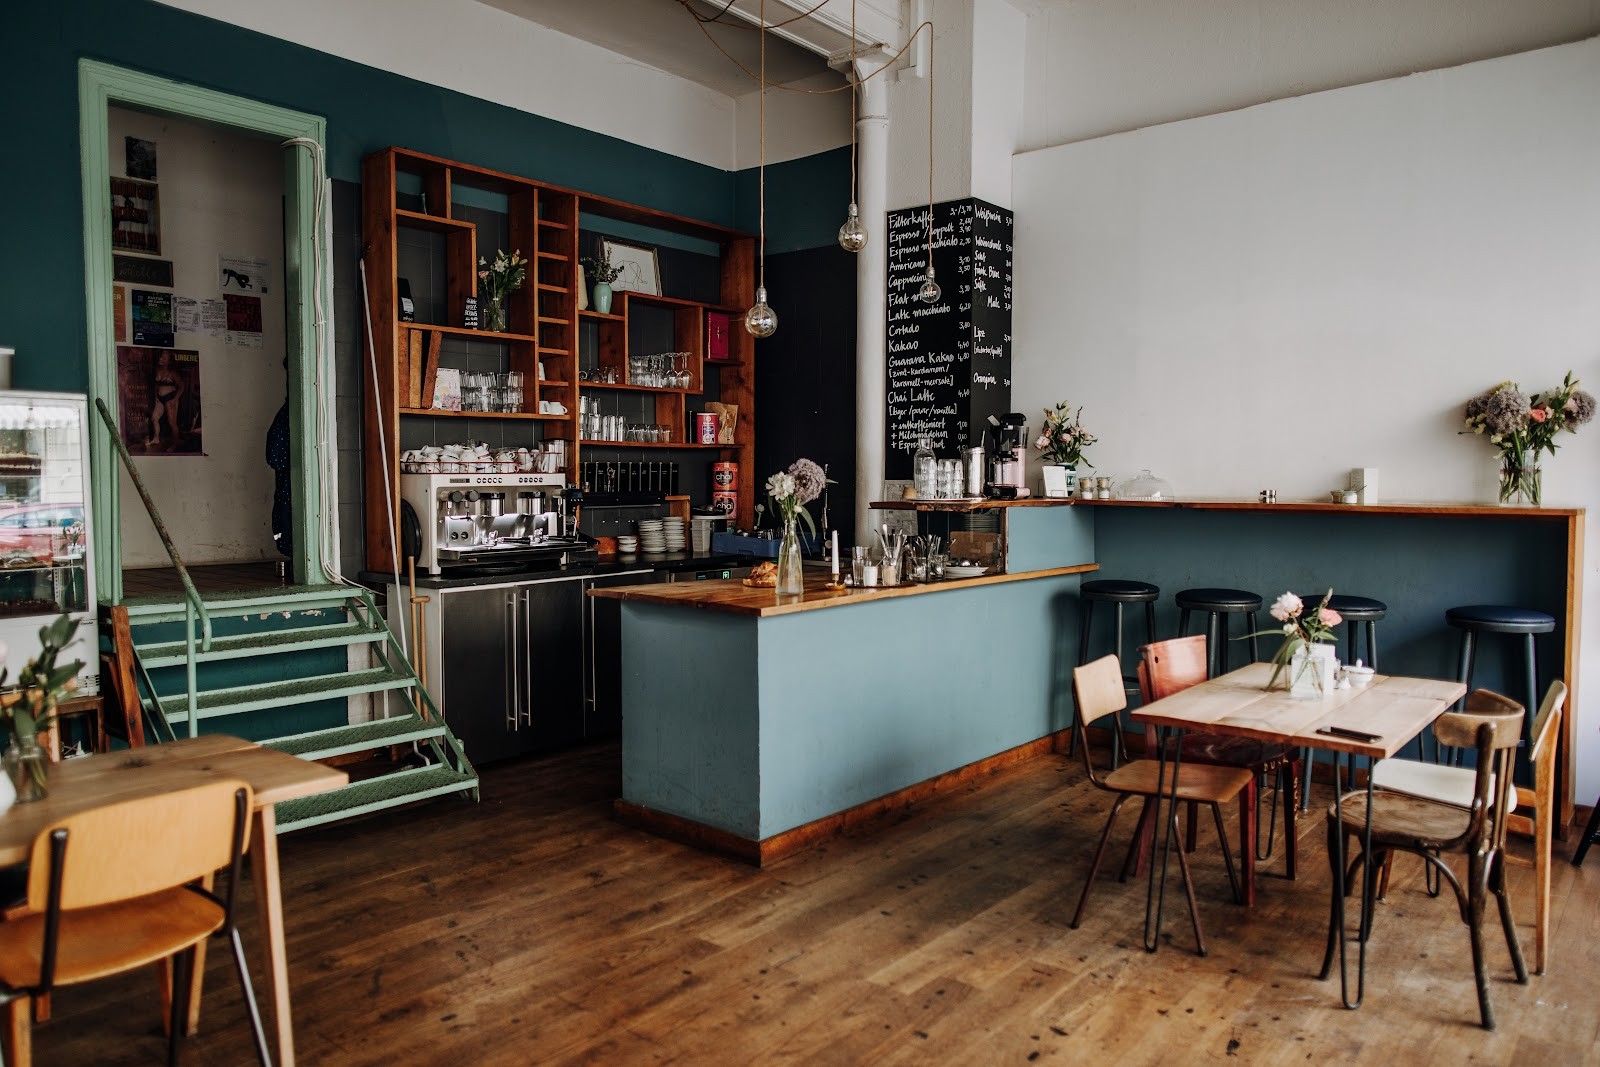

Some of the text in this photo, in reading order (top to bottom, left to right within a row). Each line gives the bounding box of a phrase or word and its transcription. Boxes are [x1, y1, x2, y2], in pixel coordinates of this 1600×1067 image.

[889, 230, 920, 247] Espresso
[889, 245, 920, 262] Espresso
[889, 259, 926, 272] Americano
[887, 293, 910, 307] Flat
[888, 308, 910, 322] Latte
[912, 303, 951, 317] macchiato
[888, 323, 920, 337] Cortado
[888, 339, 919, 353] Kakao
[888, 355, 926, 368] Guarana
[928, 351, 954, 364] Kakao
[888, 391, 908, 404] Chai
[910, 388, 936, 402] Latte
[898, 440, 922, 455] Espres
